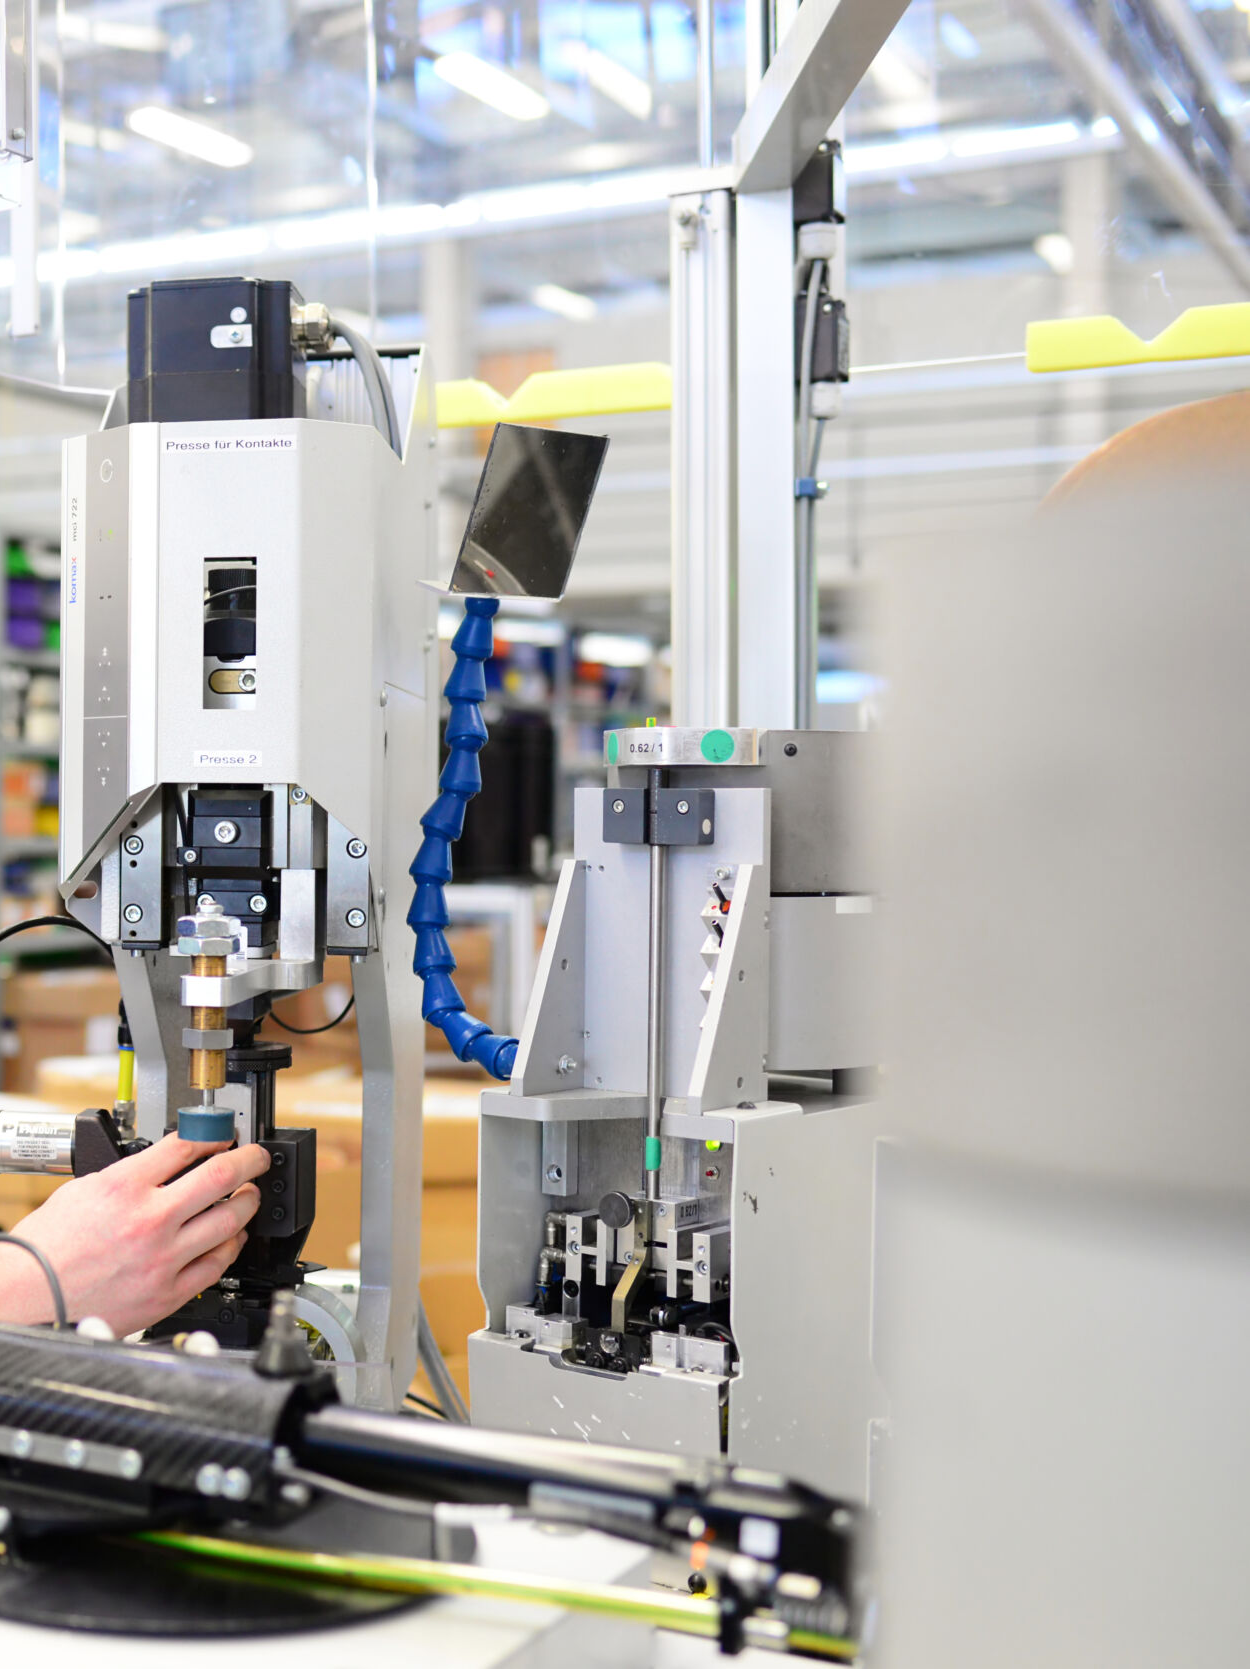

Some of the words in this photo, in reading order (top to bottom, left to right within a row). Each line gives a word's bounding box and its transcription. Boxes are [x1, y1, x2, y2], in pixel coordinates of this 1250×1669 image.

[166, 441, 210, 451] Presse
[214, 440, 232, 449] für
[235, 439, 292, 448] Kontakte
[69, 556, 78, 604] komax
[629, 743, 649, 753] 0.62
[200, 754, 245, 764] Presse
[249, 754, 258, 764] 2
